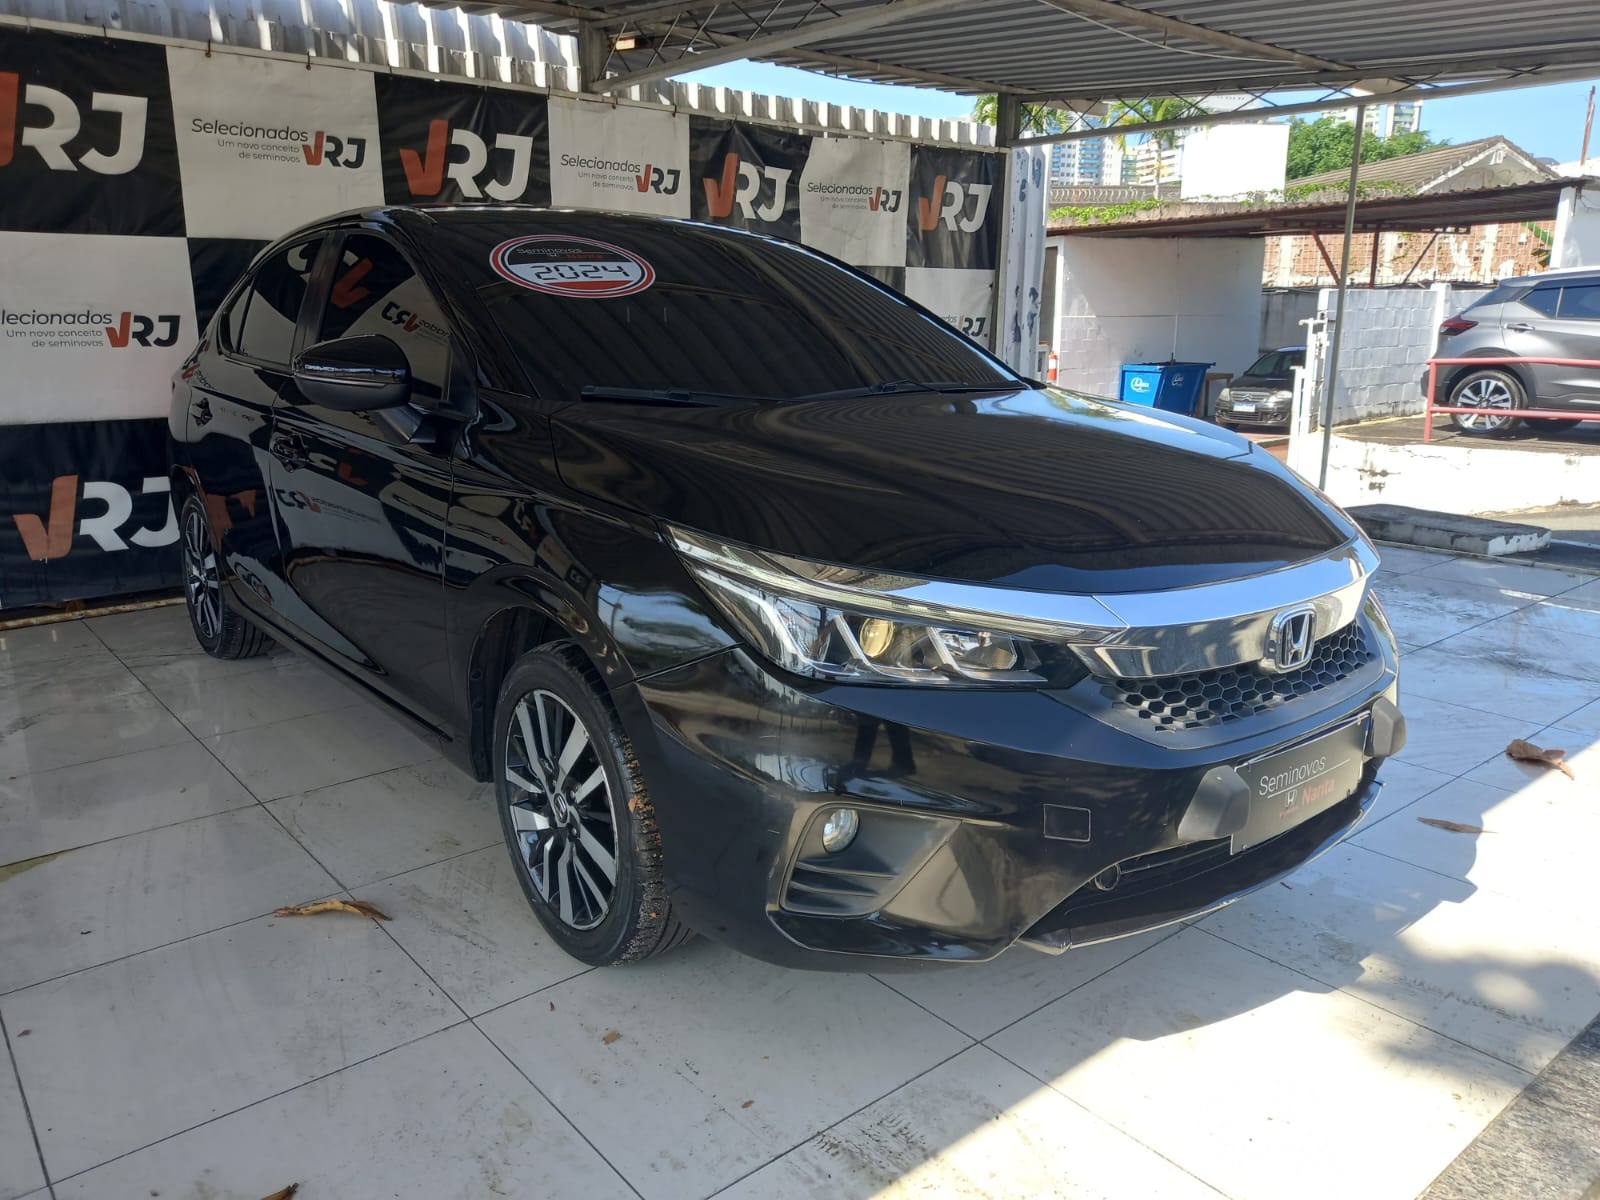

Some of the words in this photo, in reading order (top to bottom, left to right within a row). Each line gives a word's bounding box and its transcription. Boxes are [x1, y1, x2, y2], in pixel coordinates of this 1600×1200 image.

[191, 118, 309, 143] Selecionados
[302, 130, 367, 169] VRJ
[217, 139, 235, 149] Um
[237, 142, 259, 150] novo
[260, 144, 300, 154] conceito
[238, 151, 251, 160] de
[252, 152, 301, 163] seminovos
[400, 119, 534, 201] VRJ
[560, 153, 641, 174] Selecionados
[635, 163, 681, 195] VRJ
[702, 152, 792, 222] VRJ
[807, 182, 874, 196] Selecionados
[868, 186, 903, 213] VRJ
[918, 175, 992, 233] VRJ
[530, 263, 631, 281] 2024
[1, 308, 113, 326] lecionados
[105, 311, 181, 348] VRJ
[6, 329, 26, 338] Um
[29, 330, 56, 338] novo
[57, 329, 103, 338] conceito
[31, 338, 46, 348] de
[48, 339, 104, 348] seminovos
[12, 474, 181, 561] VRJ
[1258, 756, 1327, 796] Seminovos
